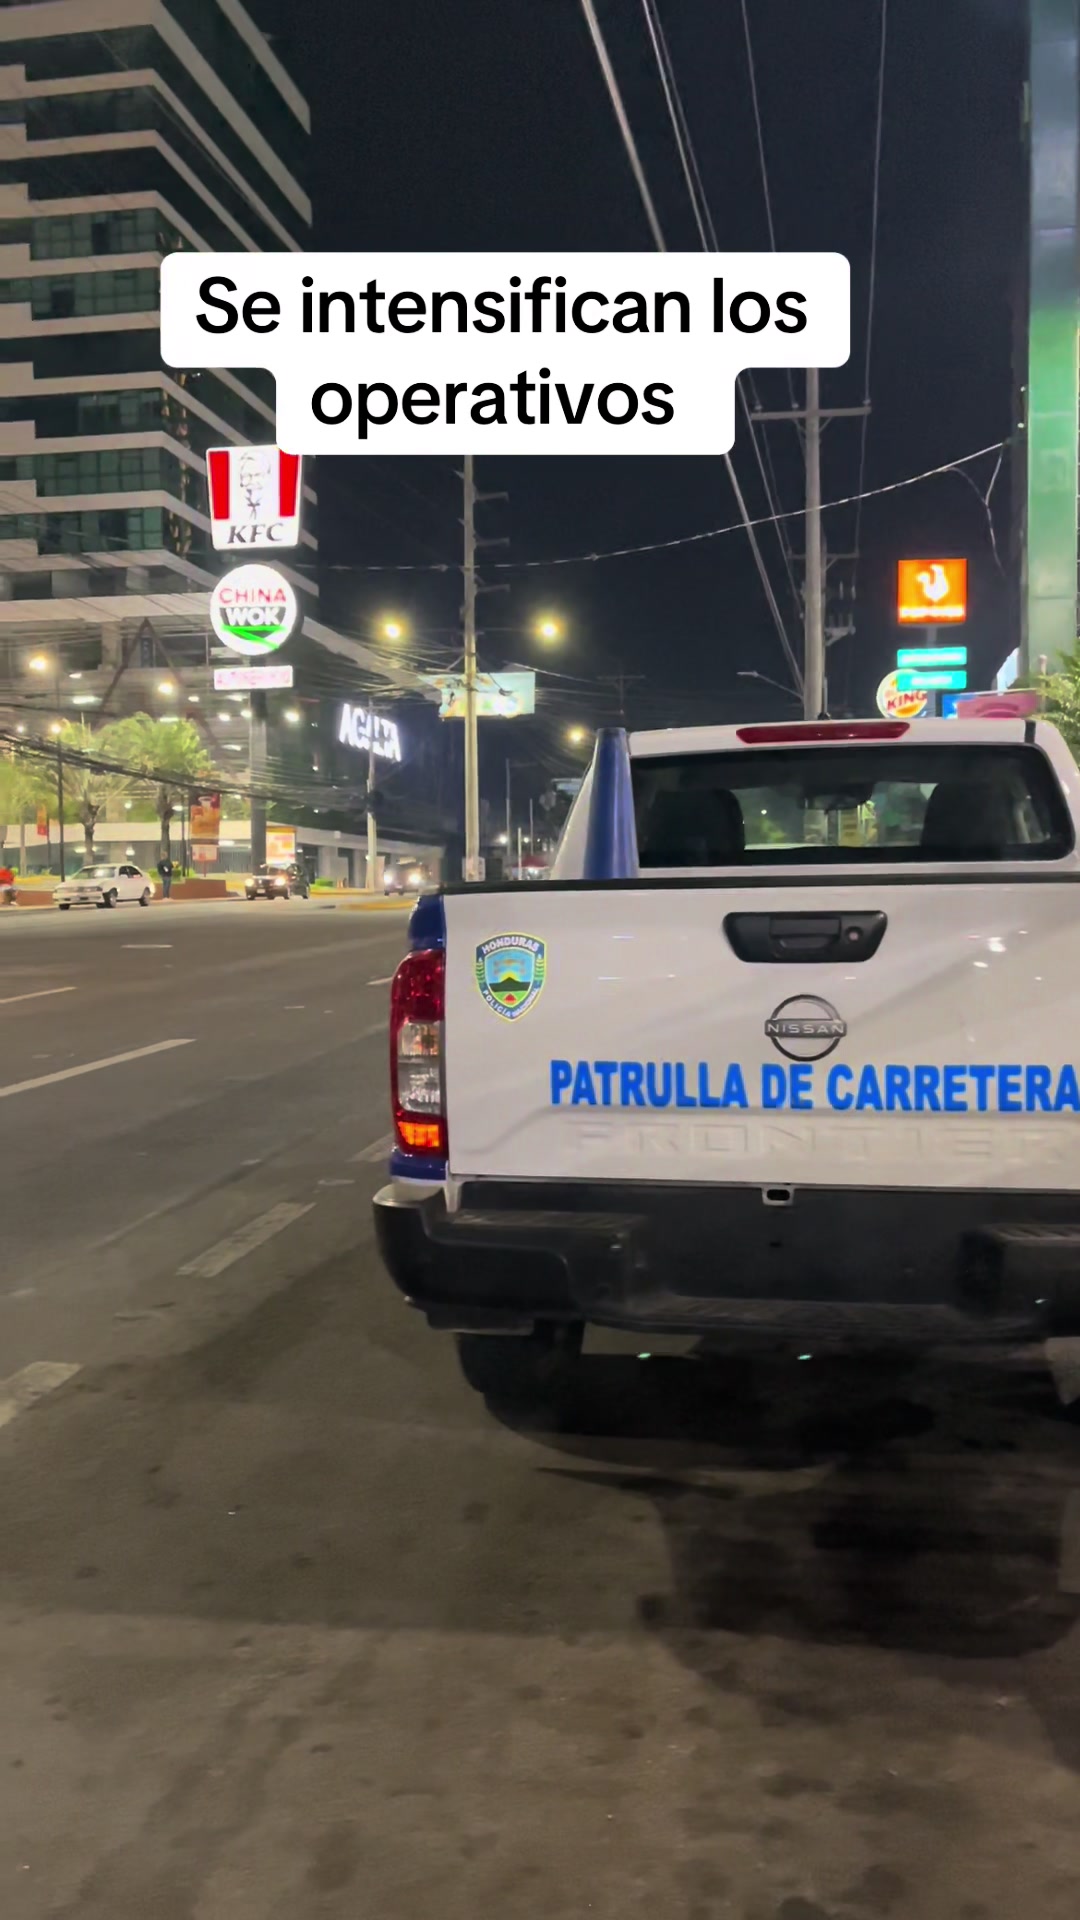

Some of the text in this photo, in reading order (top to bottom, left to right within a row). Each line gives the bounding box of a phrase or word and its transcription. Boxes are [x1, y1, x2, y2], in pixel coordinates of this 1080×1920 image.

[227, 523, 284, 544] KFC
[219, 588, 287, 604] CHINA
[225, 607, 281, 626] WOK
[887, 689, 928, 711] KING
[481, 936, 540, 954] HONDURAS
[767, 1023, 844, 1034] NISSAN
[550, 1060, 1080, 1113] PATRULLA DE CARRETERA
[564, 1119, 1073, 1163] FRONTIER
